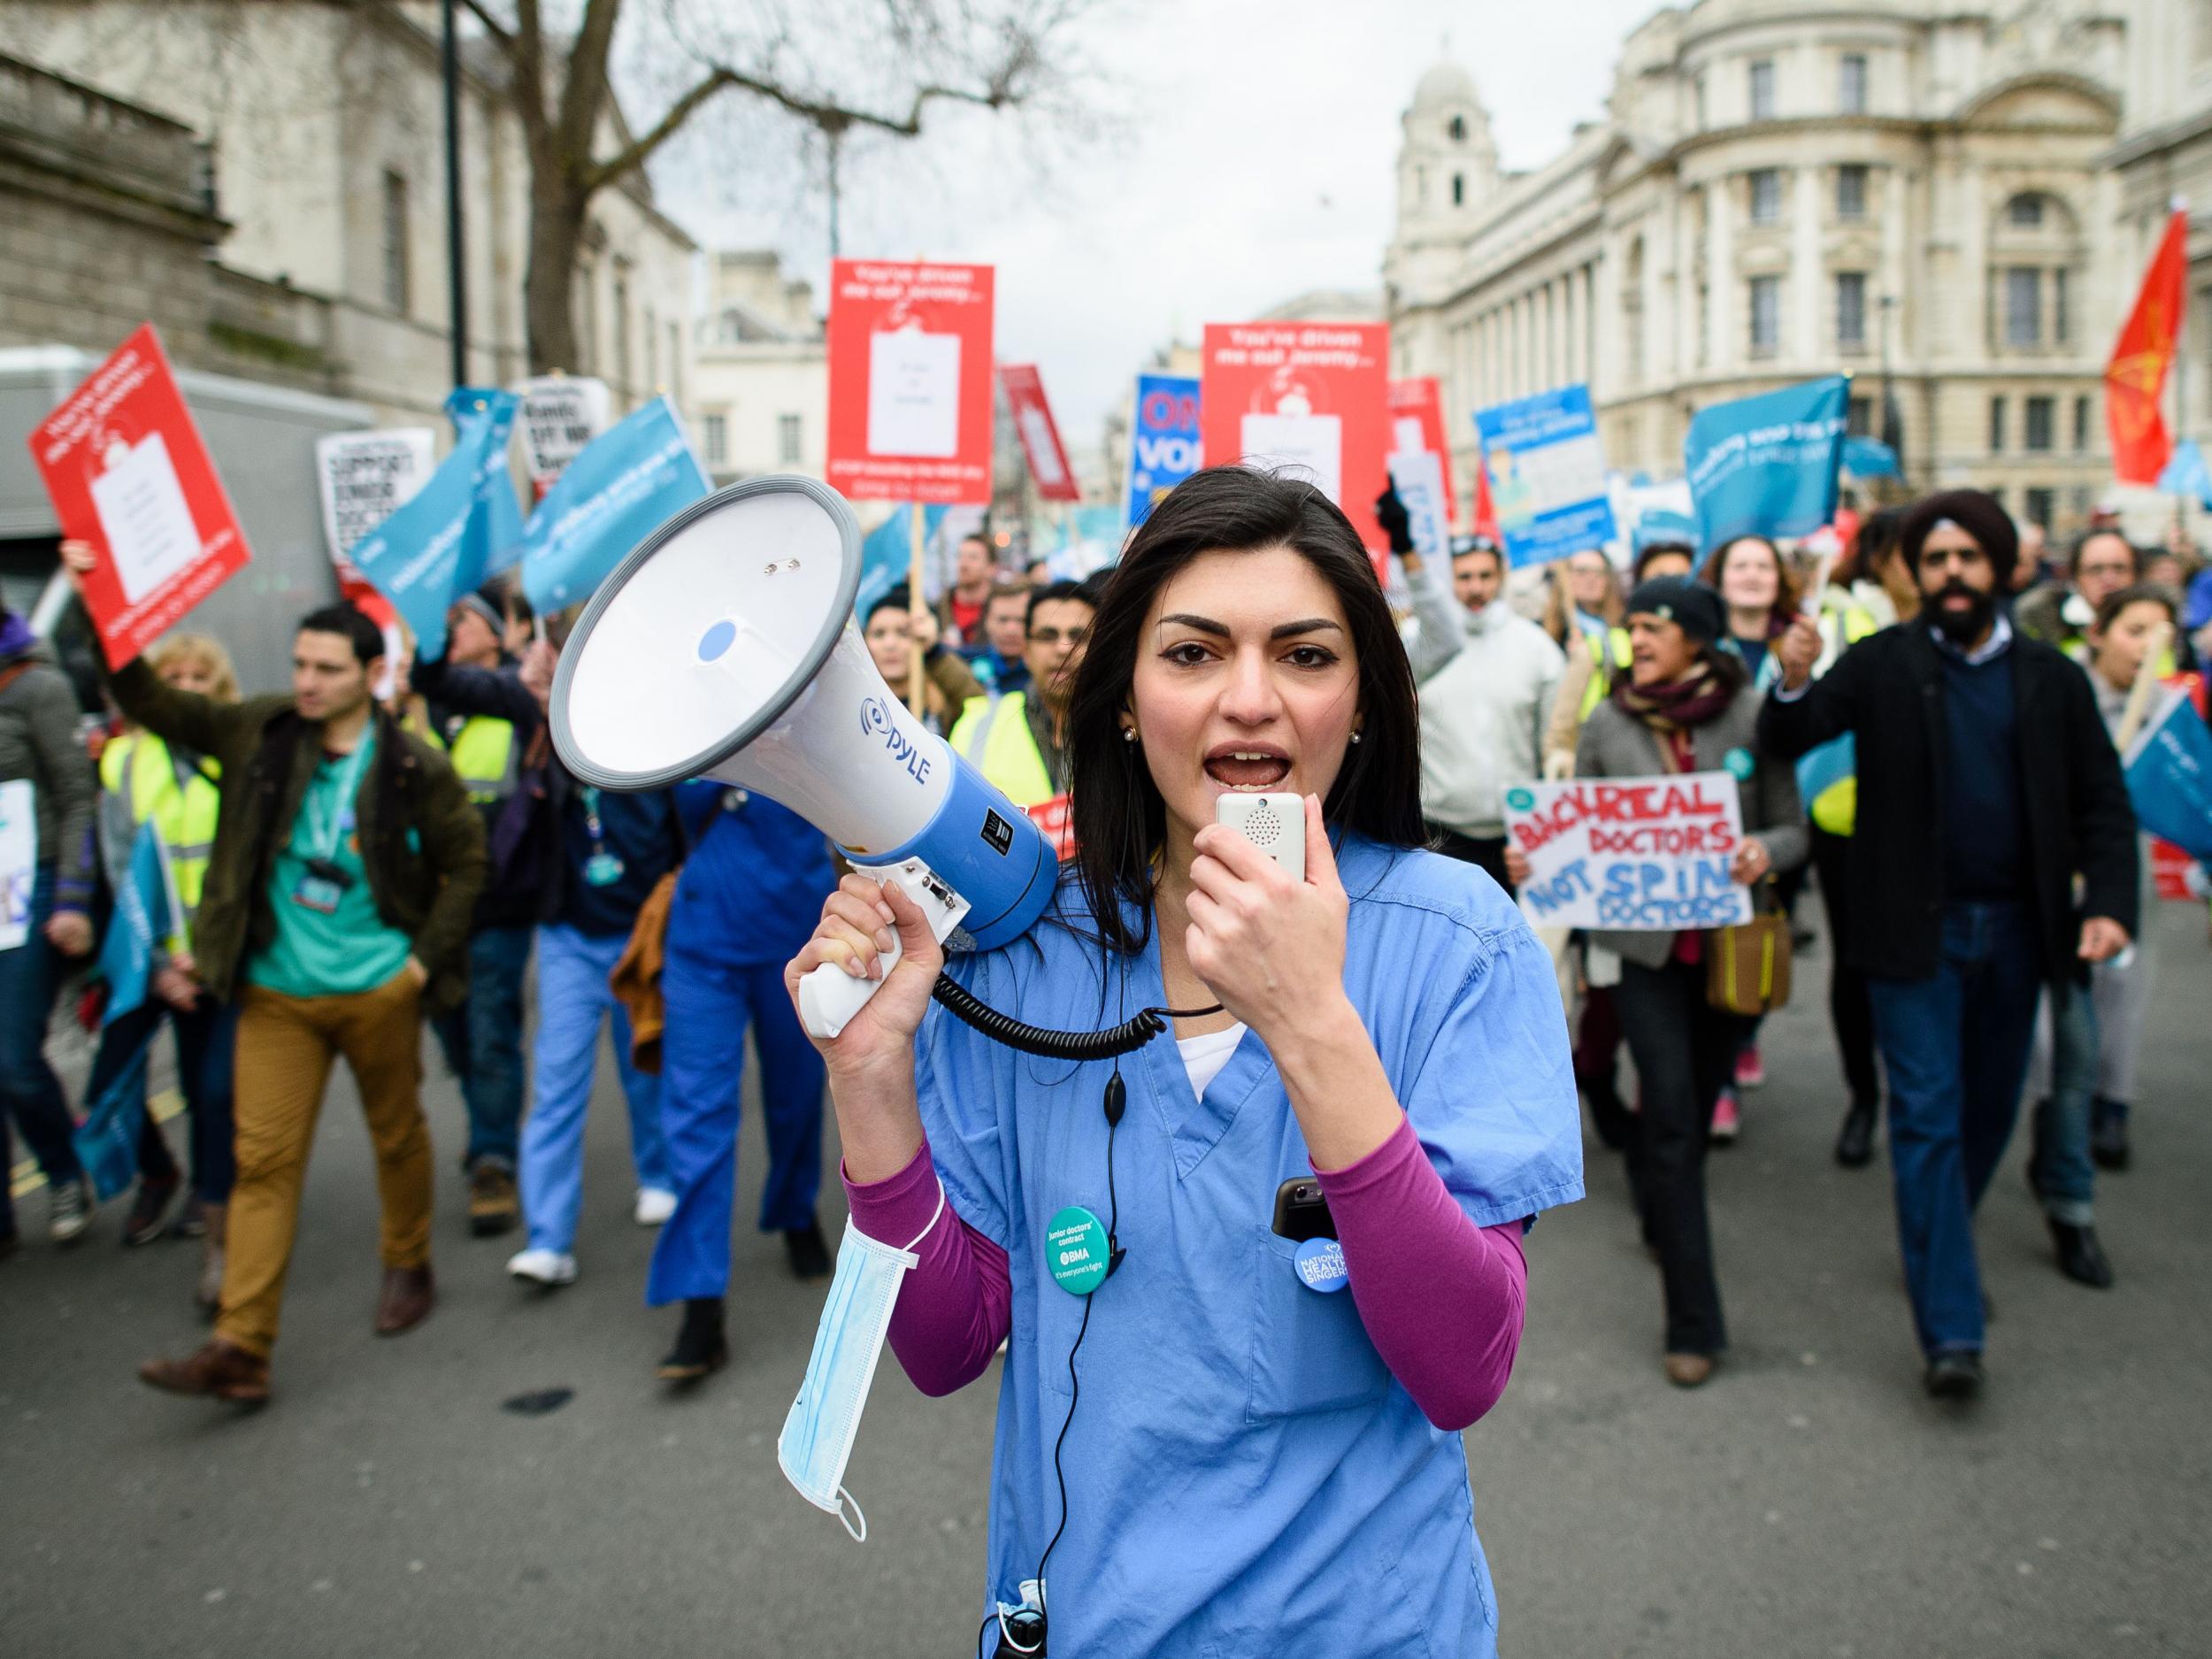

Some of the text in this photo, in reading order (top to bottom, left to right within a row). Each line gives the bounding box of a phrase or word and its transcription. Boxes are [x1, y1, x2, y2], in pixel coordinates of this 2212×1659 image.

[1301, 330, 1363, 347] driven
[1215, 349, 1247, 365] me
[1250, 349, 1284, 365] out
[1594, 781, 1723, 822] REAL
[1589, 820, 1736, 856] DOCTORS
[1526, 856, 1732, 918] NOT SPIN
[1598, 892, 1741, 926] DOCTORS
[1048, 1229, 1066, 1241] Junior
[1058, 1233, 1086, 1247] contract
[1068, 1248, 1090, 1263] BMA
